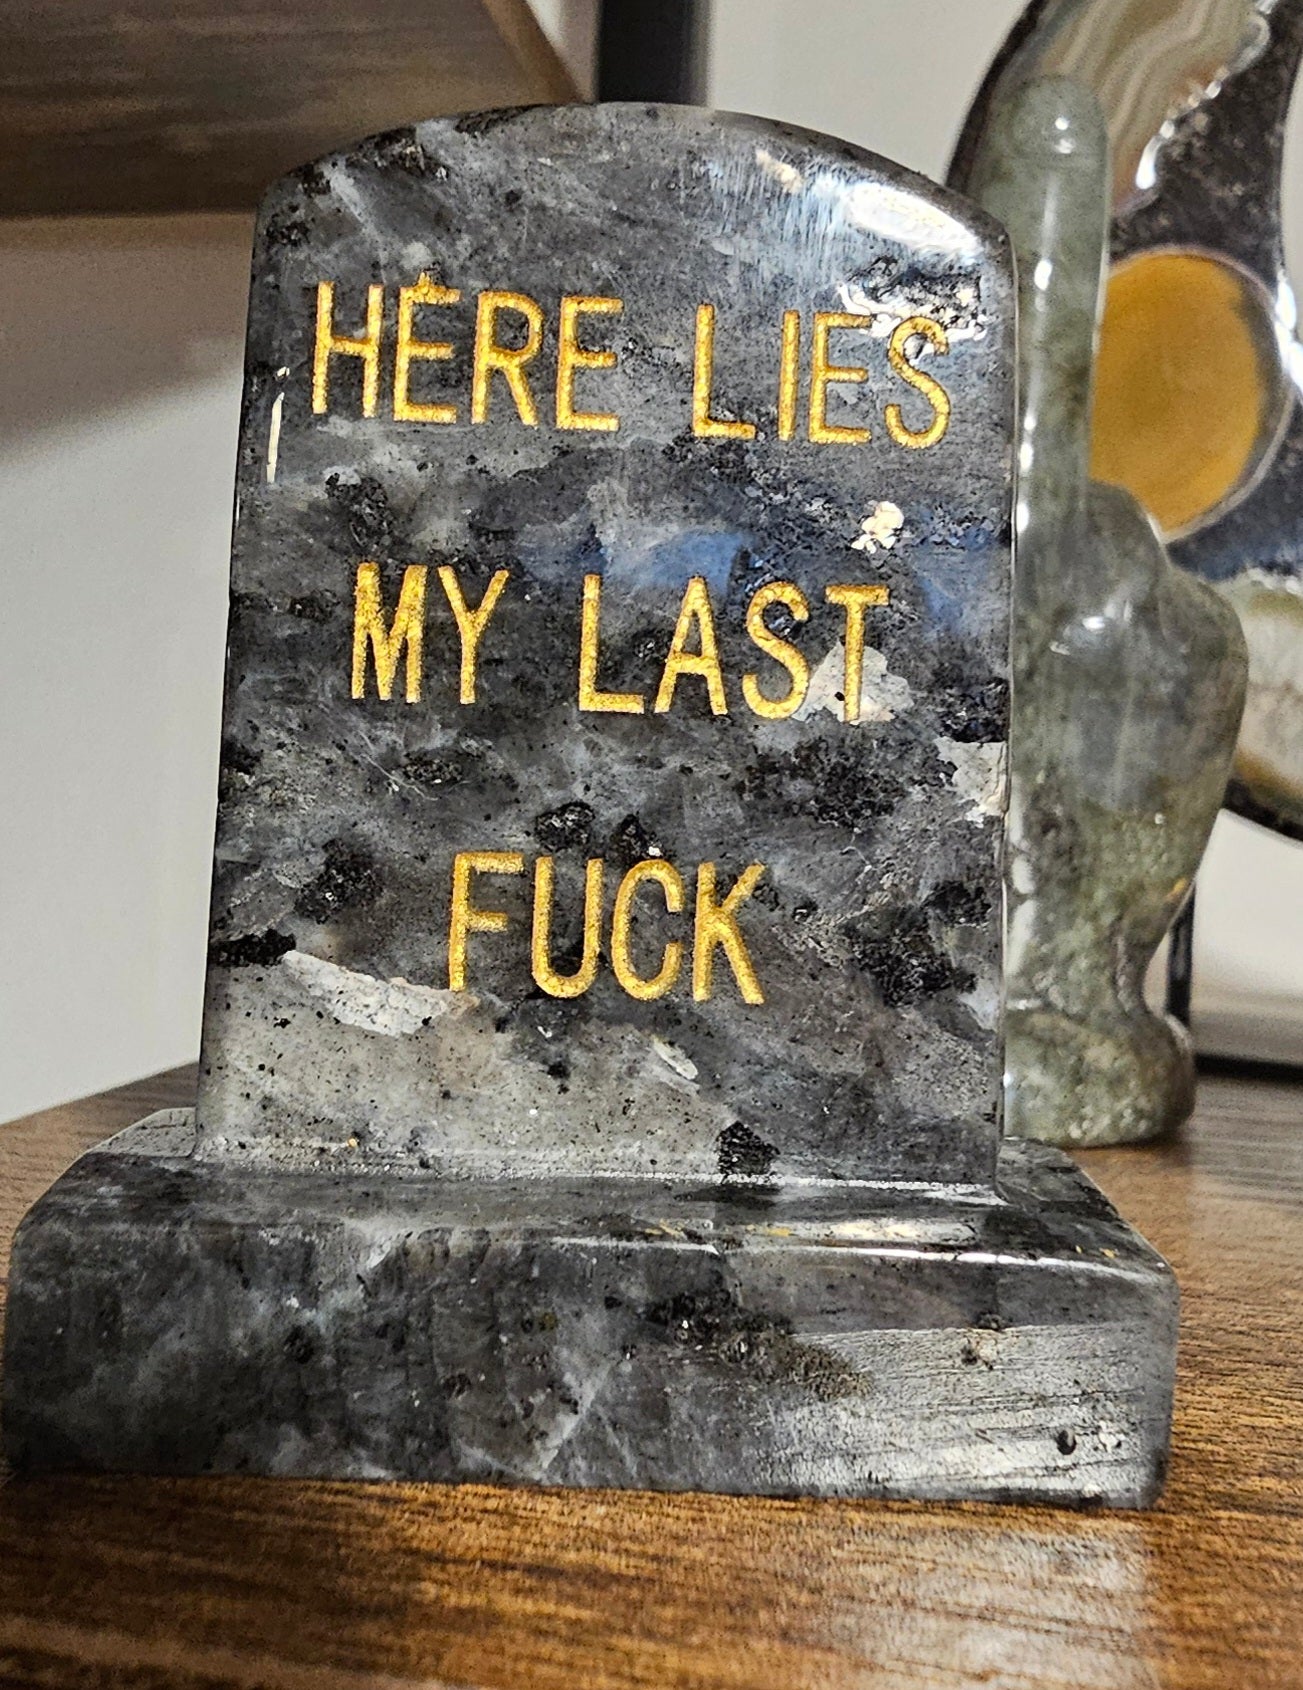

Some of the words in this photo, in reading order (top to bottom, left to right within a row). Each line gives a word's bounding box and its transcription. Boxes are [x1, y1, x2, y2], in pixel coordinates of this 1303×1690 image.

[312, 279, 623, 432] HERE
[692, 303, 951, 449] LIES
[351, 561, 510, 704] MY
[578, 574, 890, 724] LAST
[447, 851, 766, 1005] FUCK
